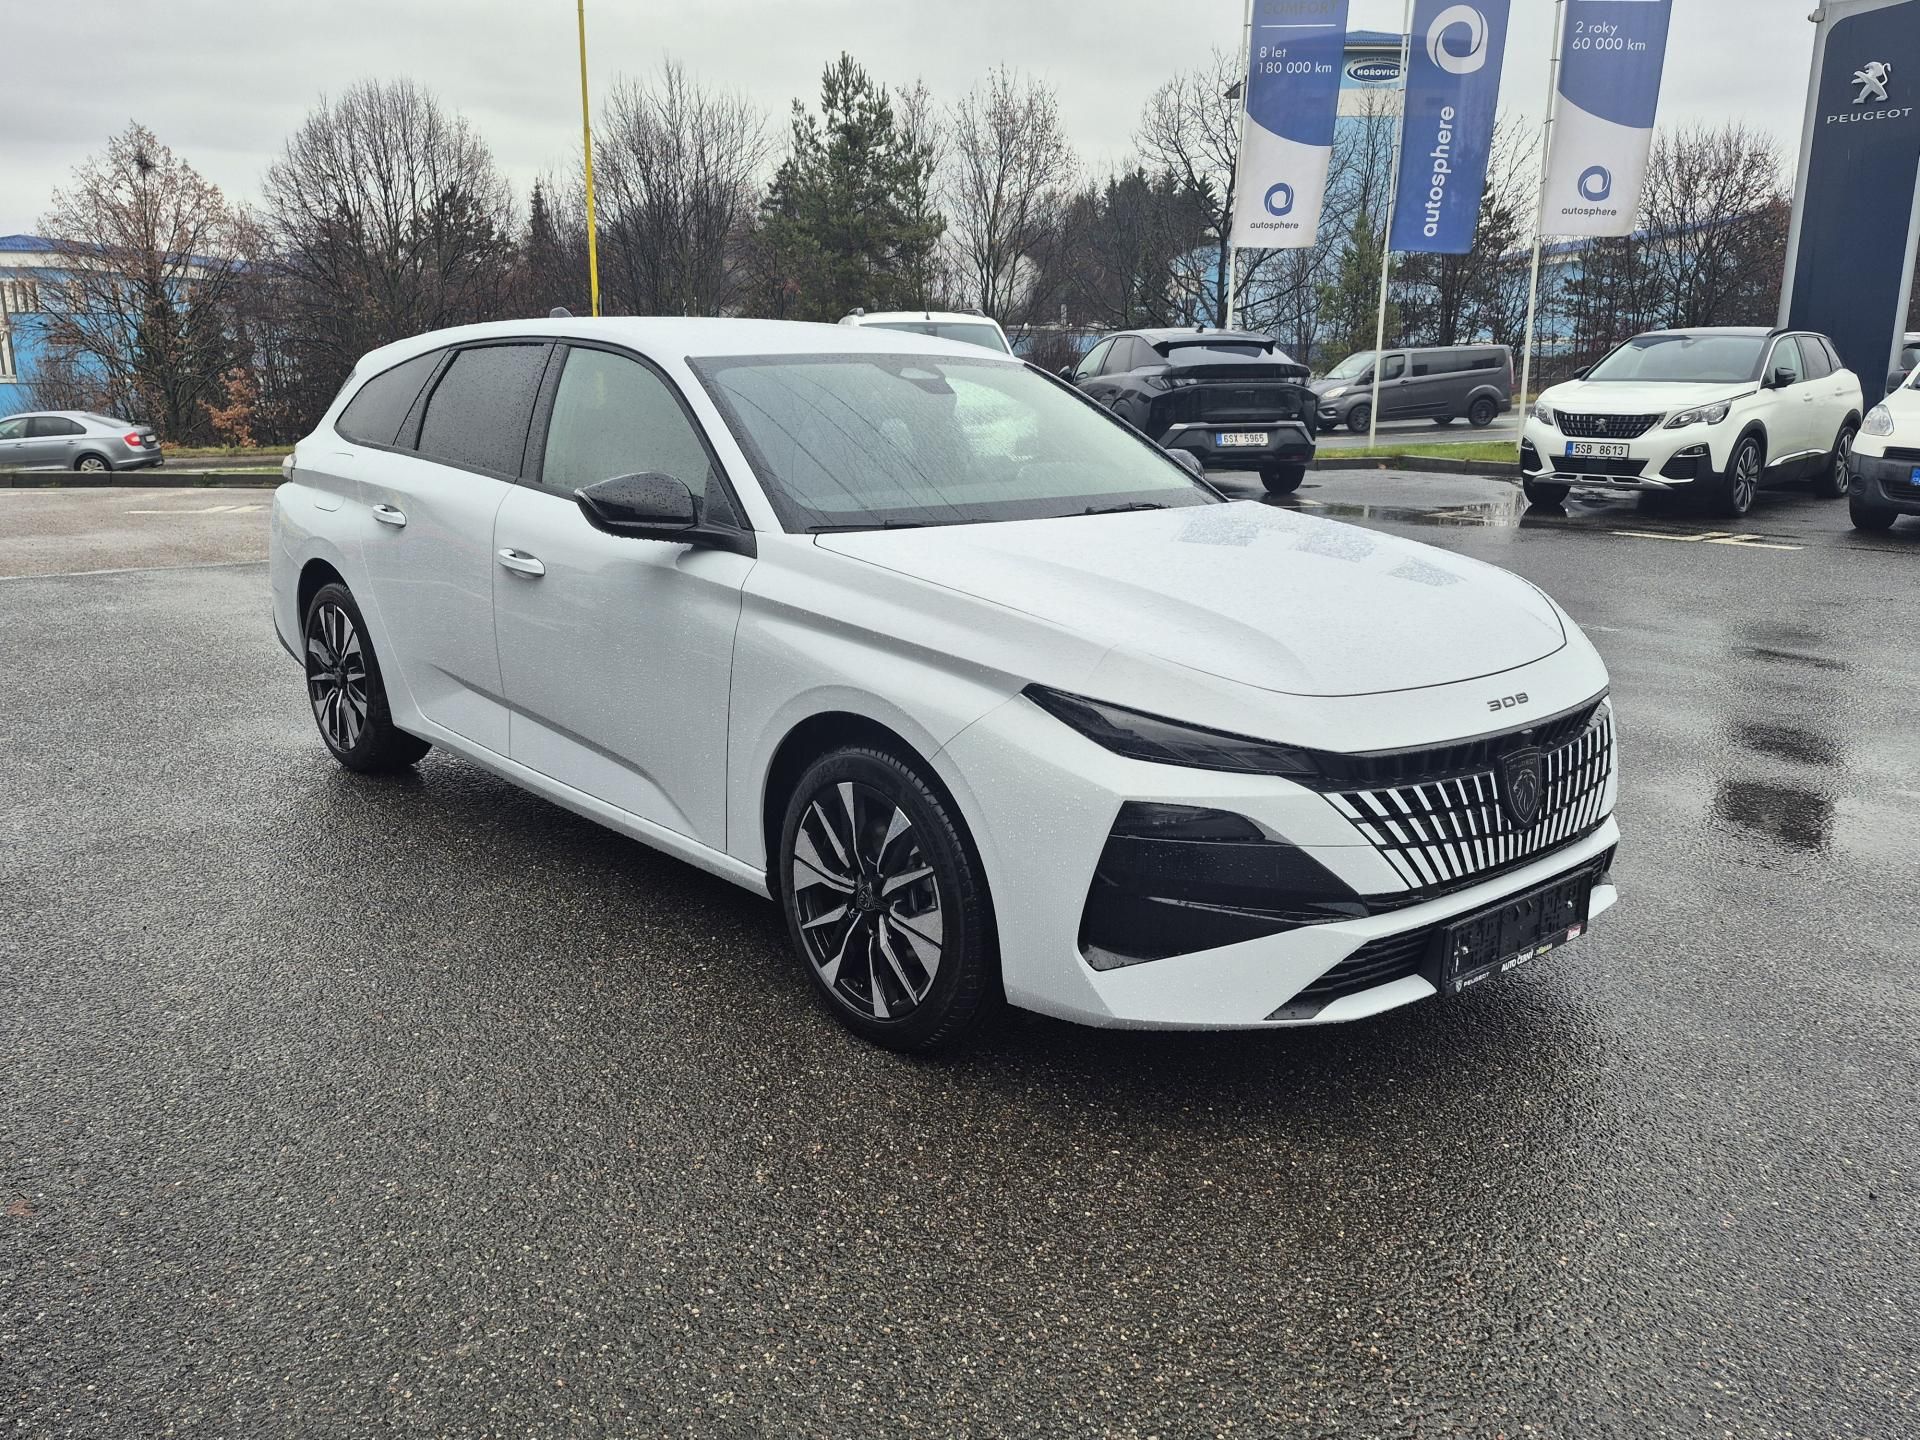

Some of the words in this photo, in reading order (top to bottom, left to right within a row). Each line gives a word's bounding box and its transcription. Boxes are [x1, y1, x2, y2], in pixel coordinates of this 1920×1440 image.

[1575, 20, 1584, 33] 2
[1588, 21, 1618, 36] roky
[1572, 37, 1591, 50] 60
[1595, 37, 1623, 50] 000
[1627, 38, 1646, 51] km
[1259, 46, 1268, 58] 8
[1271, 45, 1287, 58] let
[1259, 61, 1282, 74] 180
[1286, 61, 1311, 74] 000
[1315, 61, 1332, 73] km
[1826, 107, 1913, 124] PEUGEOT
[1423, 105, 1455, 237] autosphere
[1561, 206, 1617, 217] autosphere
[1250, 221, 1299, 231] autosphere
[1223, 433, 1239, 444] 6SX
[1244, 433, 1265, 443] 5965
[1575, 443, 1593, 455] 5SB
[1599, 445, 1624, 456] 8613
[1487, 692, 1529, 712] 308
[1501, 958, 1517, 973] AUTO
